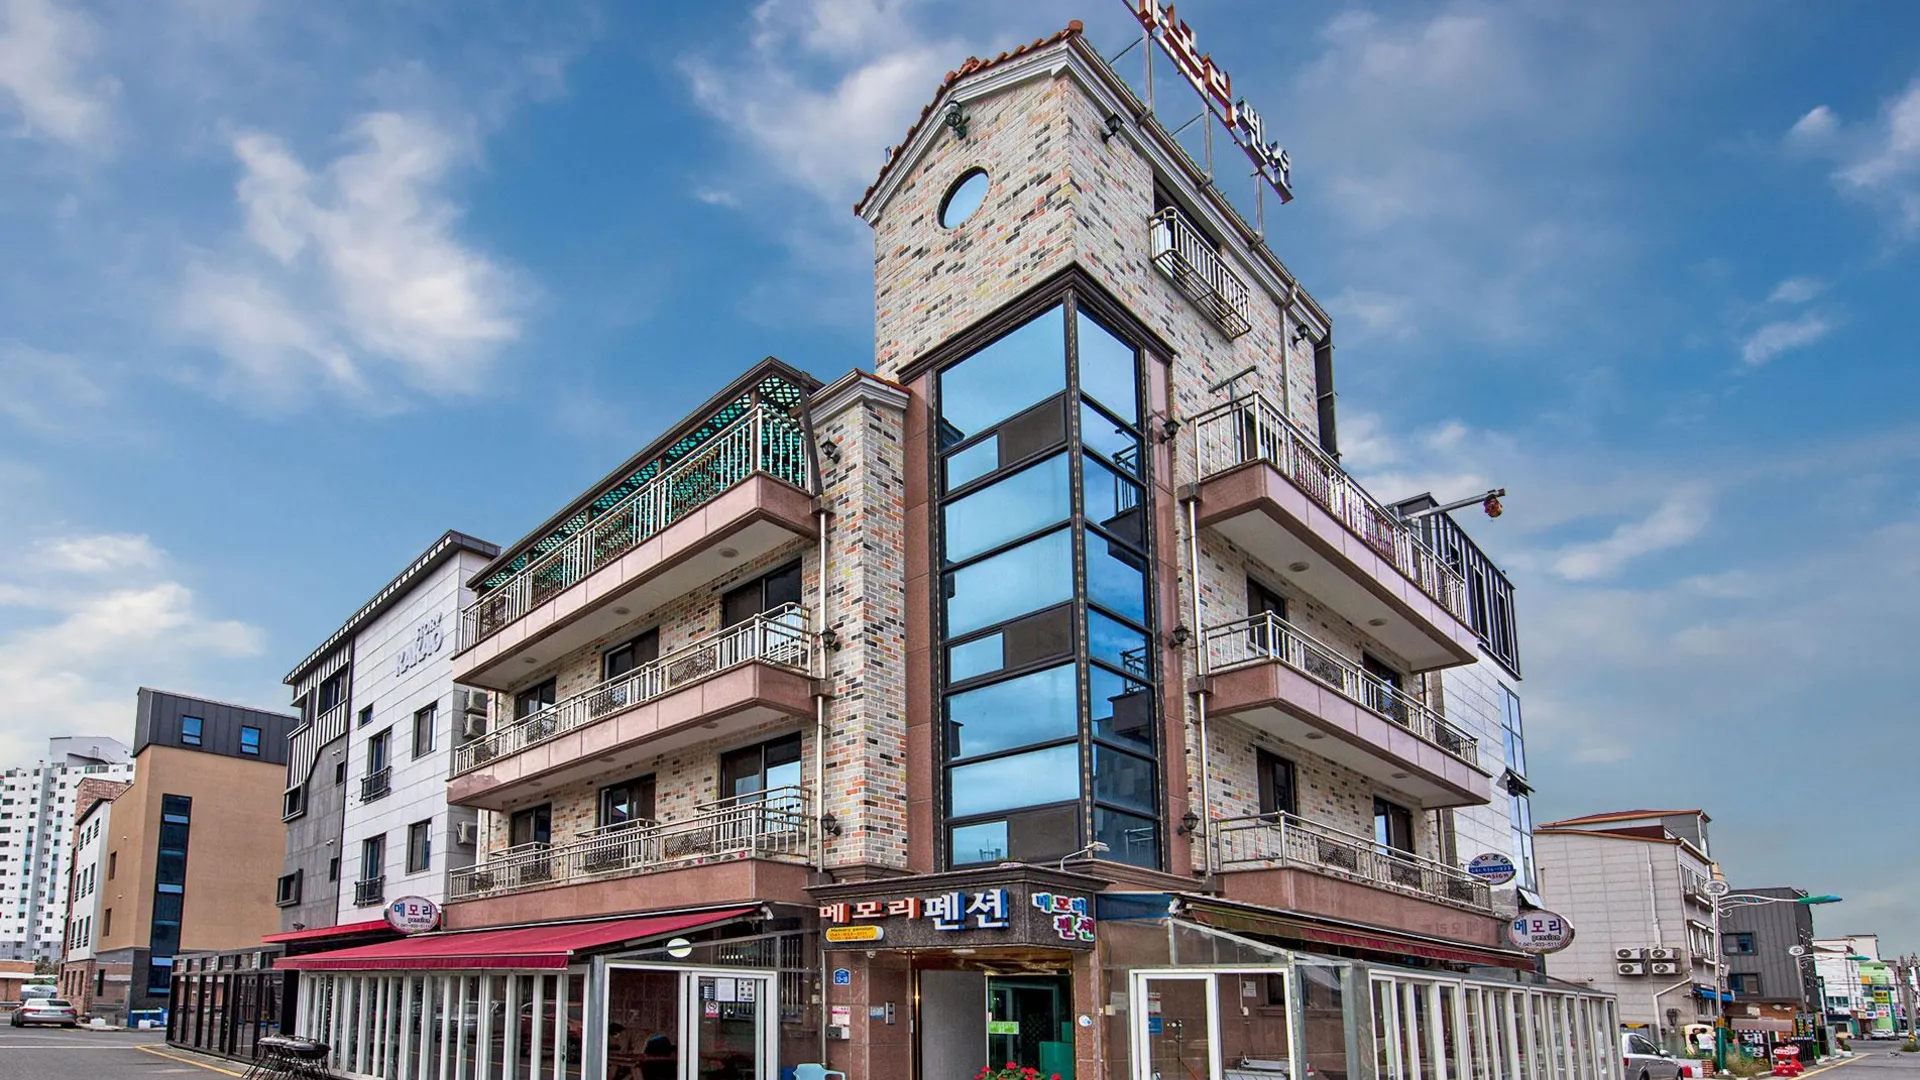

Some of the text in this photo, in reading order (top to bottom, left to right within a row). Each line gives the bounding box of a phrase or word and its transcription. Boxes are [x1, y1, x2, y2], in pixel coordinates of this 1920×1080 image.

[395, 626, 445, 678] KAKAO
[394, 902, 433, 918] 메모리
[1031, 892, 1087, 917] 메모리
[1053, 914, 1096, 942] 펜션
[1514, 918, 1562, 935] 메모리
